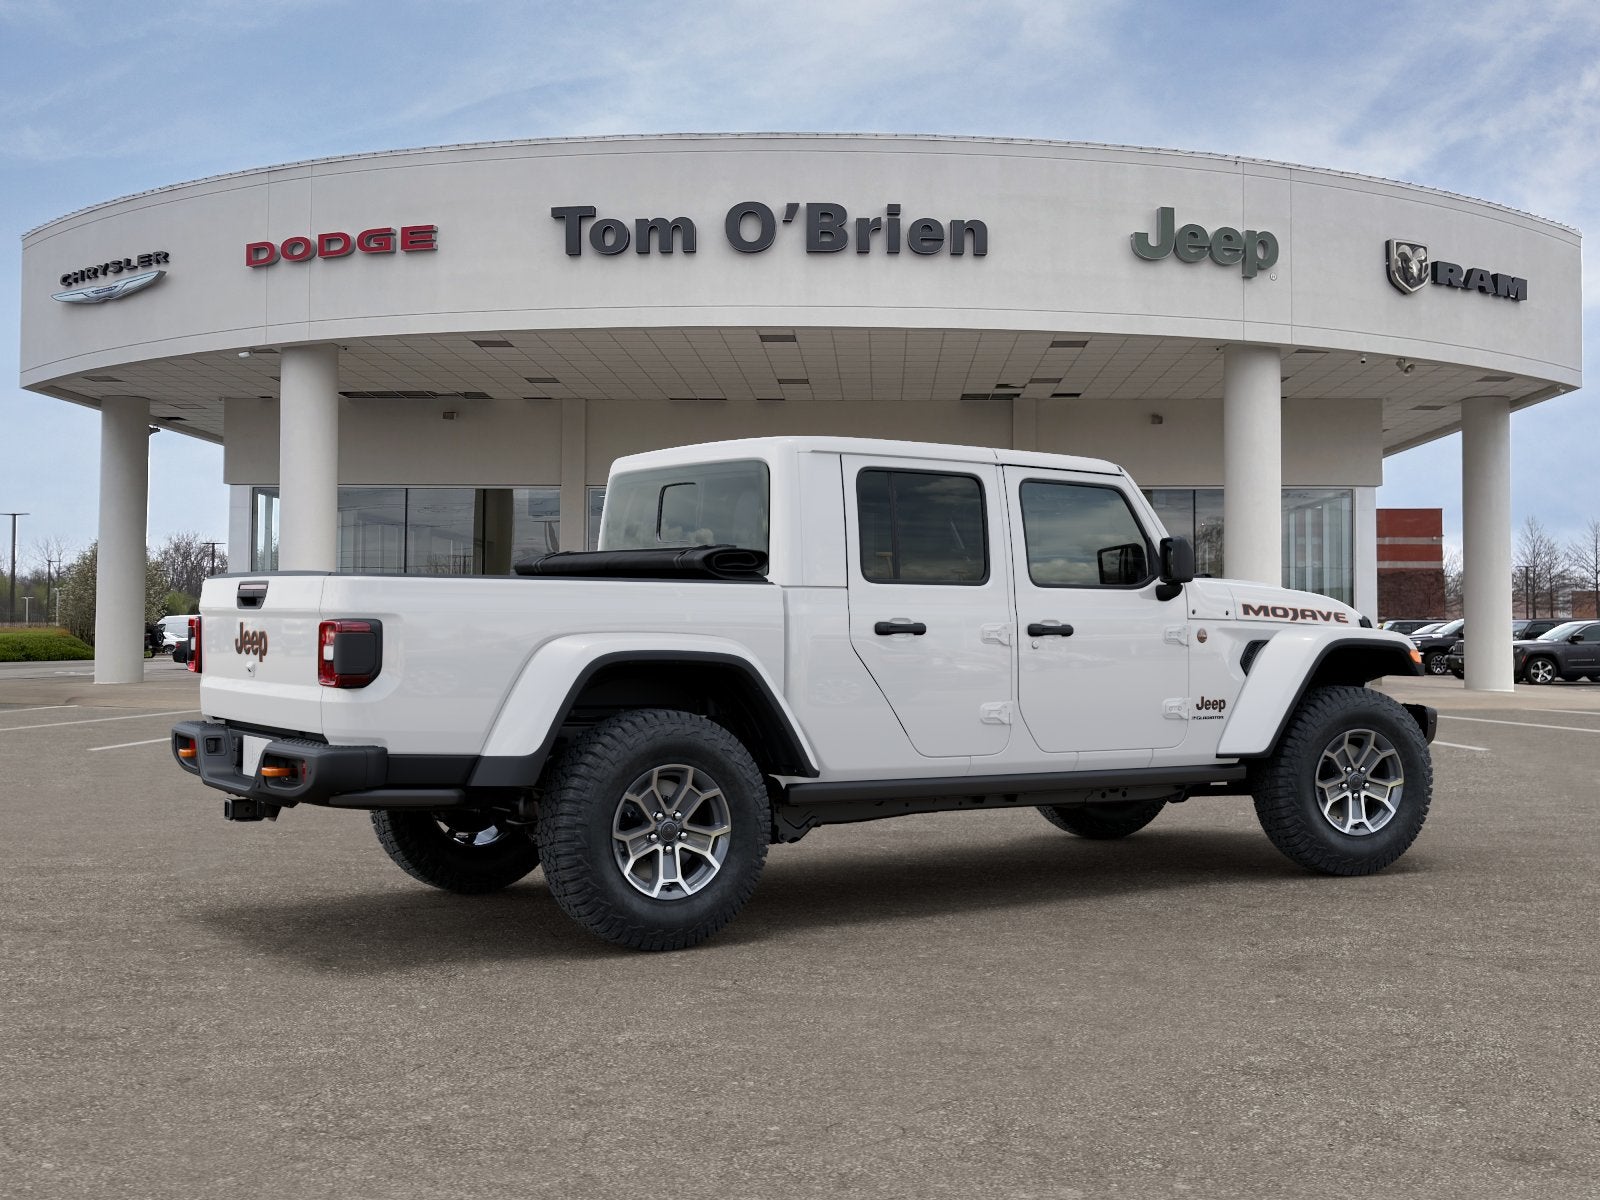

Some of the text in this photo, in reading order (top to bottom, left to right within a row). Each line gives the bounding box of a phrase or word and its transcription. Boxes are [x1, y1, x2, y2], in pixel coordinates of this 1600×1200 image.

[245, 224, 438, 268] DODGE
[551, 201, 988, 257] Tom O'Brien
[1130, 206, 1279, 279] Jeep
[60, 250, 170, 287] CHRYSLER
[1431, 260, 1528, 301] RAM
[1241, 603, 1349, 624] MOJAVE
[235, 621, 268, 663] Jeep
[1195, 695, 1227, 713] Jeep
